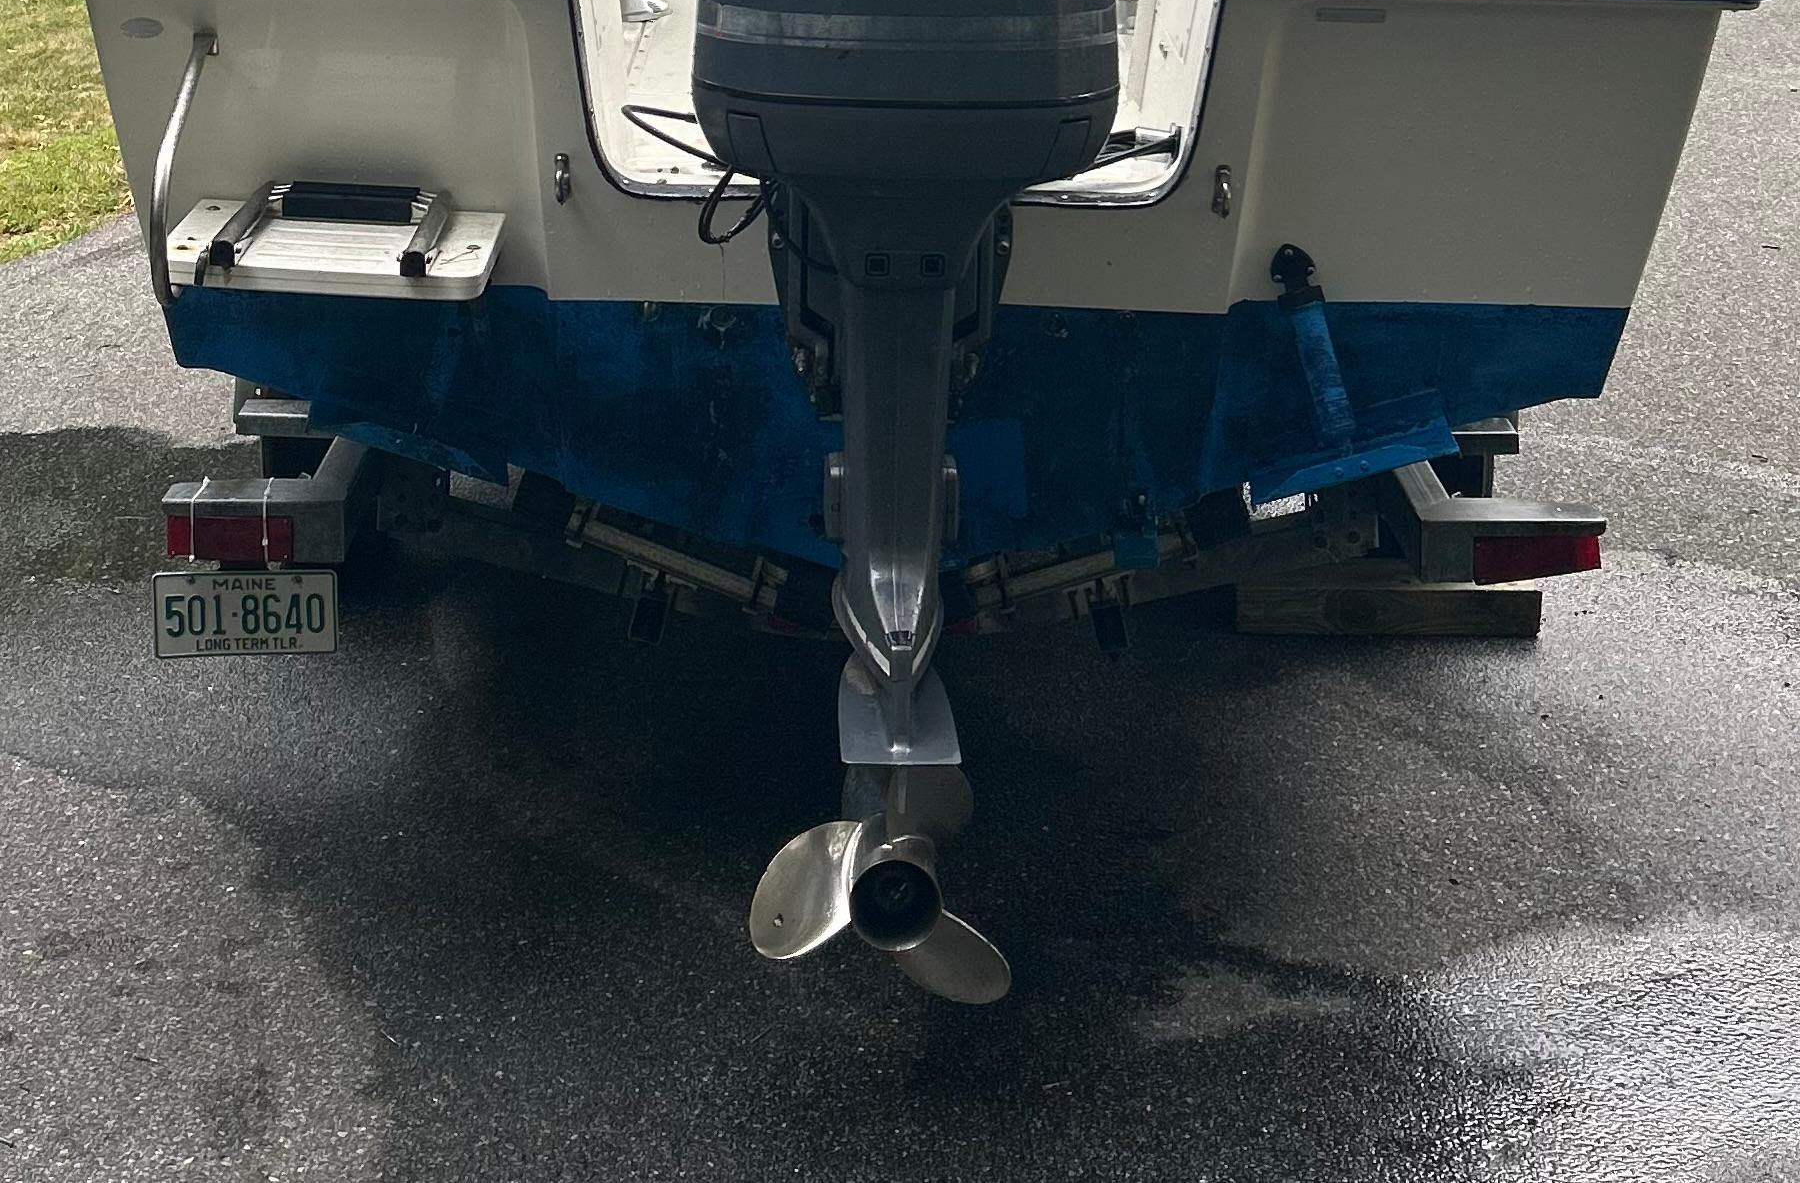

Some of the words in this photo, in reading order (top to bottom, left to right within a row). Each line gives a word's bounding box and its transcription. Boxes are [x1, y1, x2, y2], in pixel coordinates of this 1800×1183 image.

[212, 578, 276, 591] MAINE
[195, 638, 231, 652] LONG
[233, 637, 269, 651] TERM
